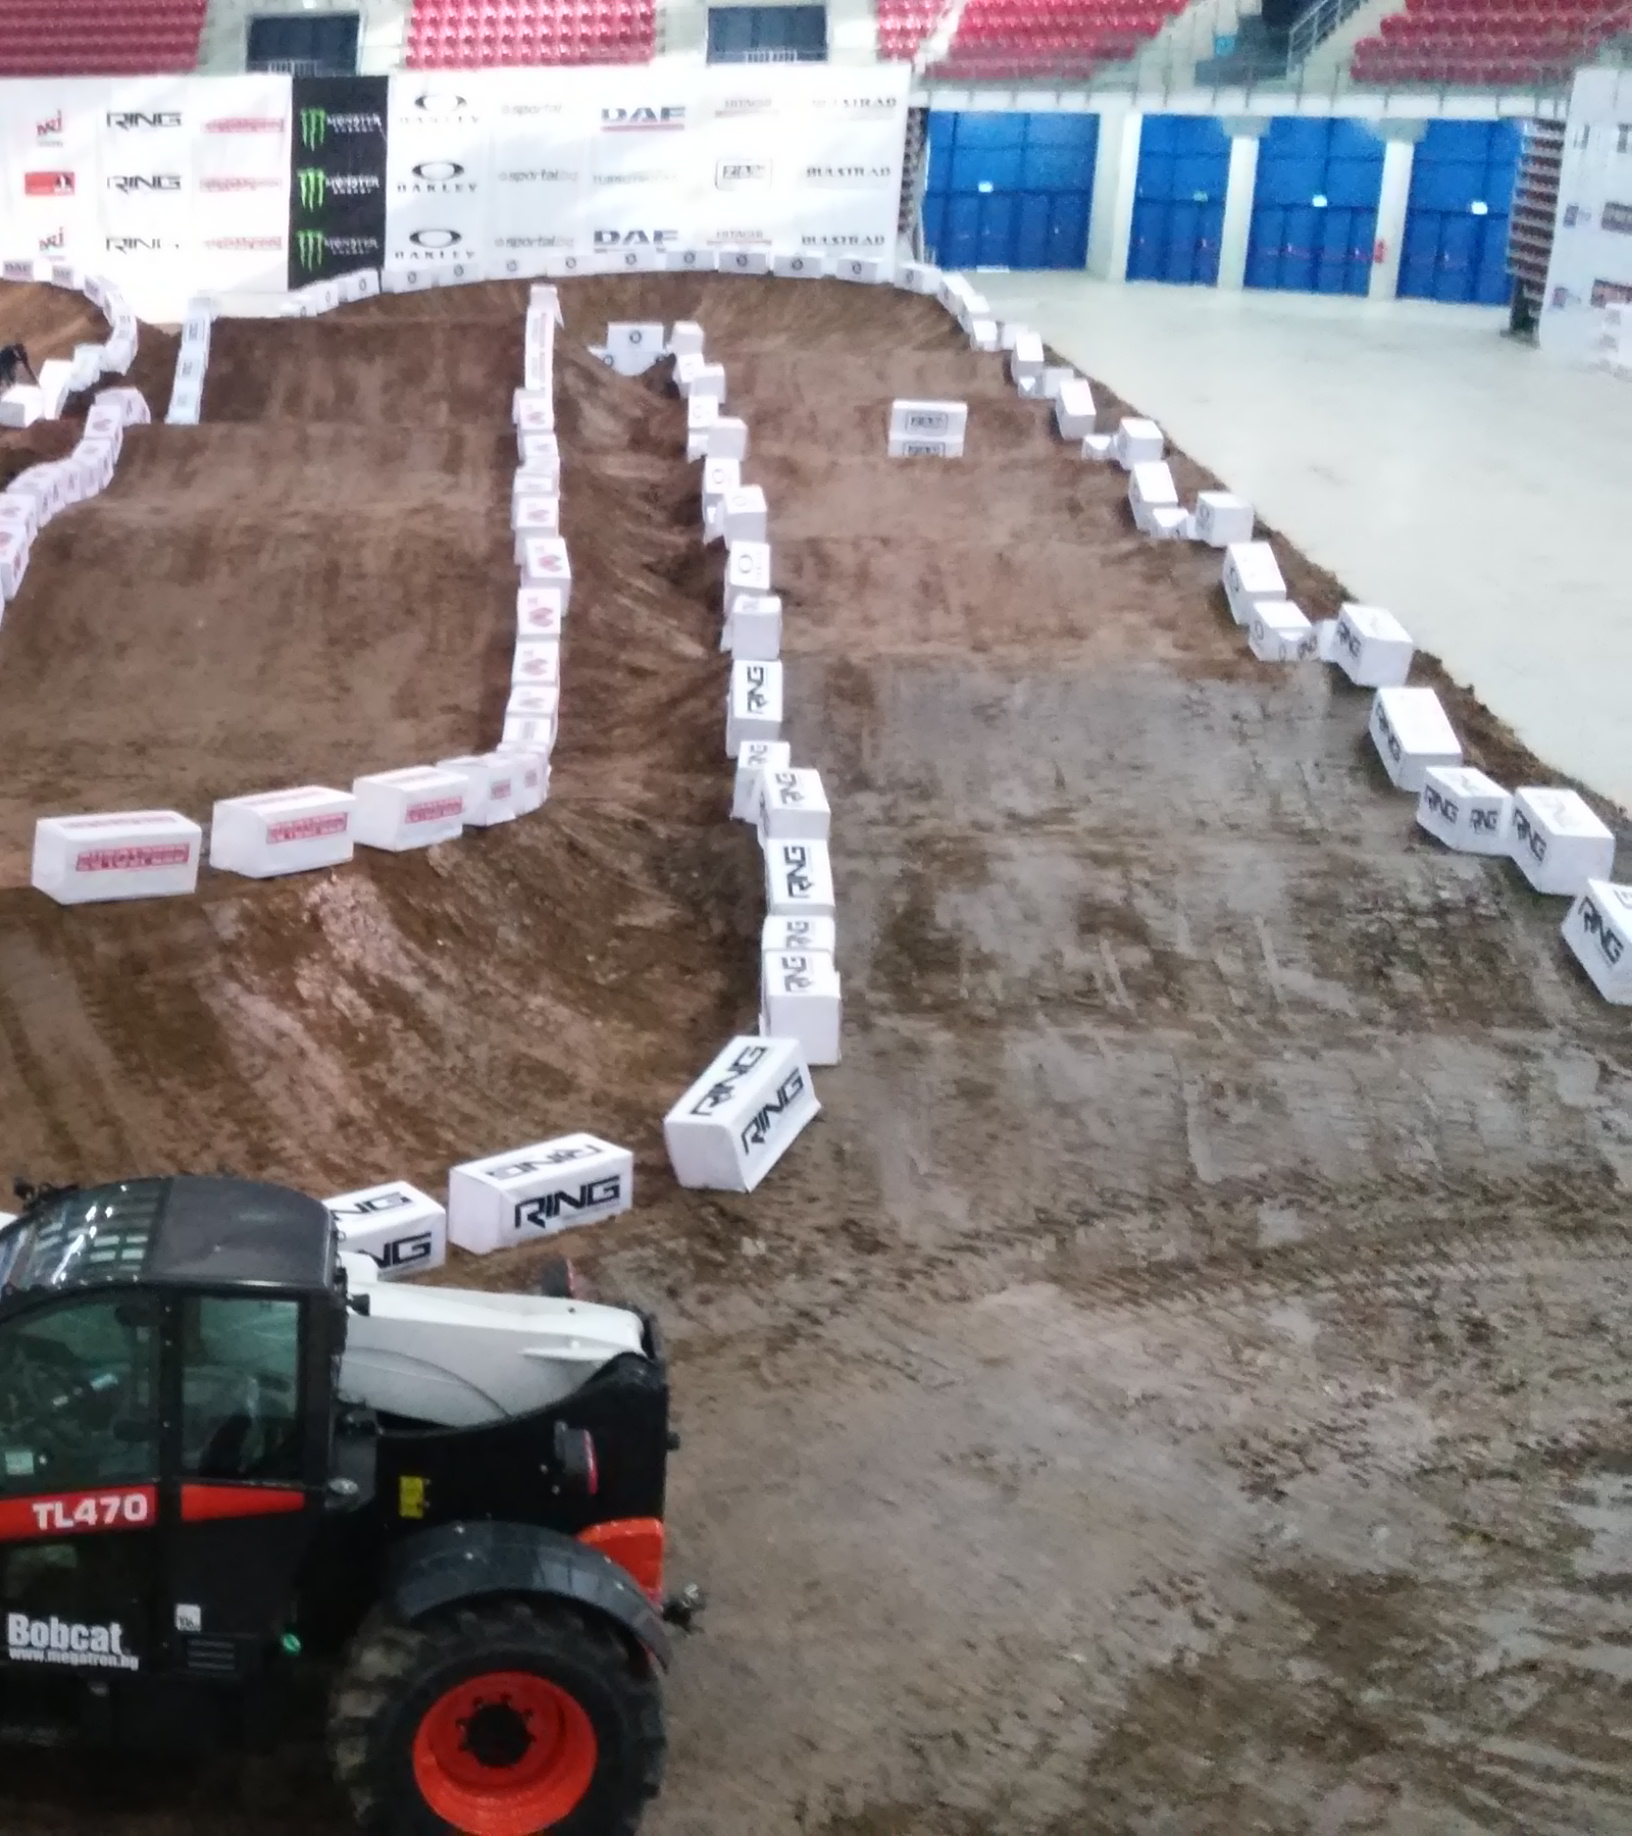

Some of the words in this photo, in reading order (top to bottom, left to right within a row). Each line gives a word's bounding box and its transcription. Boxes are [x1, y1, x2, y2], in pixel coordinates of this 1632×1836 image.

[107, 112, 182, 131] RING
[601, 107, 686, 122] DAF
[107, 175, 182, 194] RING
[594, 230, 679, 245] DAF
[689, 1046, 769, 1116] RING
[741, 1067, 804, 1155] RING
[514, 1175, 621, 1229] RING
[356, 1231, 432, 1269] NG
[32, 1493, 148, 1531] TL470
[8, 1611, 123, 1655] Bobcat
[9, 1647, 139, 1671] www.megatron.bg
